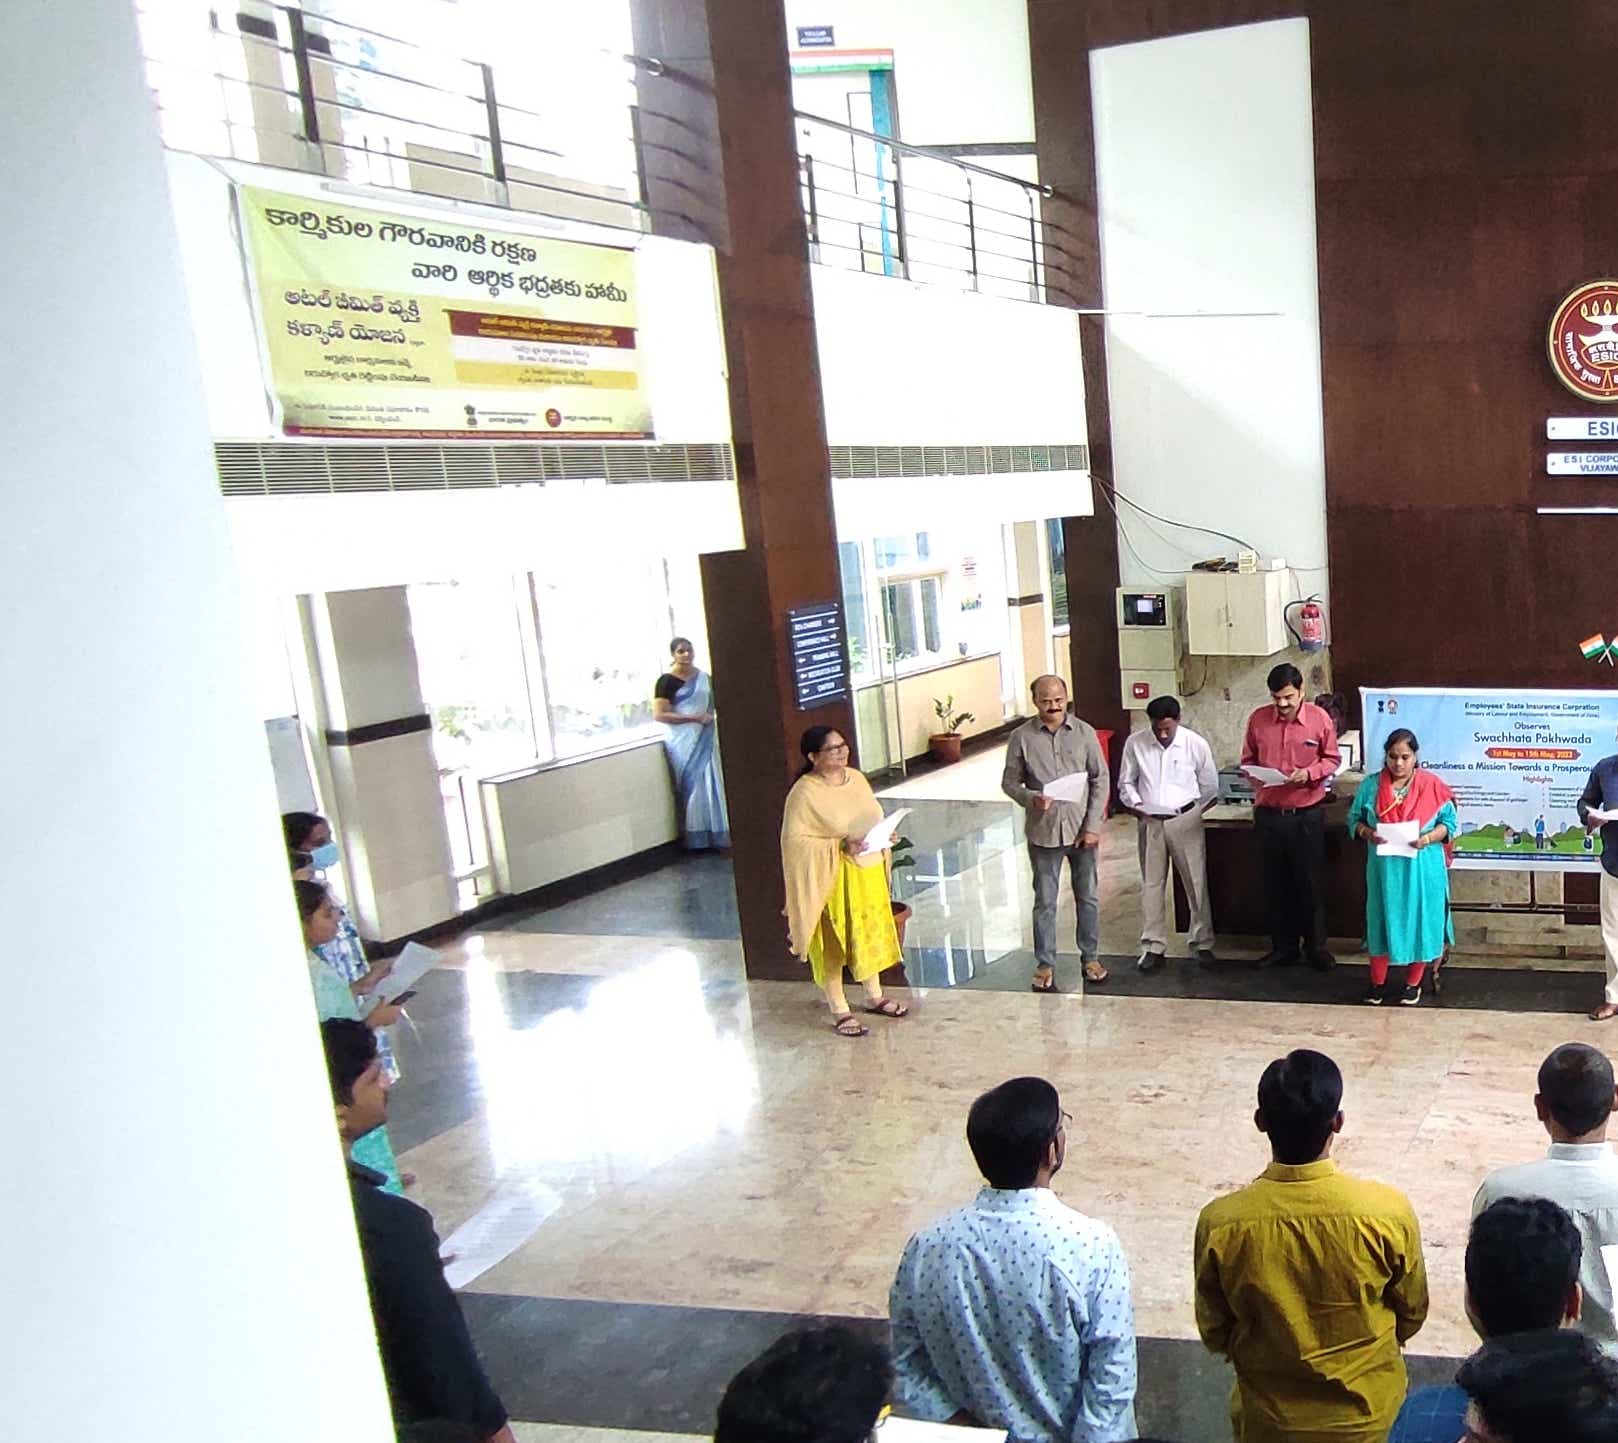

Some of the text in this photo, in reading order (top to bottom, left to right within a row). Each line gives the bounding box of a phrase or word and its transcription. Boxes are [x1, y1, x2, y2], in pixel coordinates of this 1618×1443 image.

[265, 208, 537, 265] కార్మికుల గౌరవానికి రక్షణ
[411, 262, 457, 281] వారి
[584, 282, 628, 303] హామీ
[1514, 721, 1550, 730] Observes
[1474, 731, 1532, 743] Swachhata
[1421, 761, 1465, 769] Cleanliness
[1476, 762, 1506, 770] Mission
[1509, 762, 1541, 771] Towards
